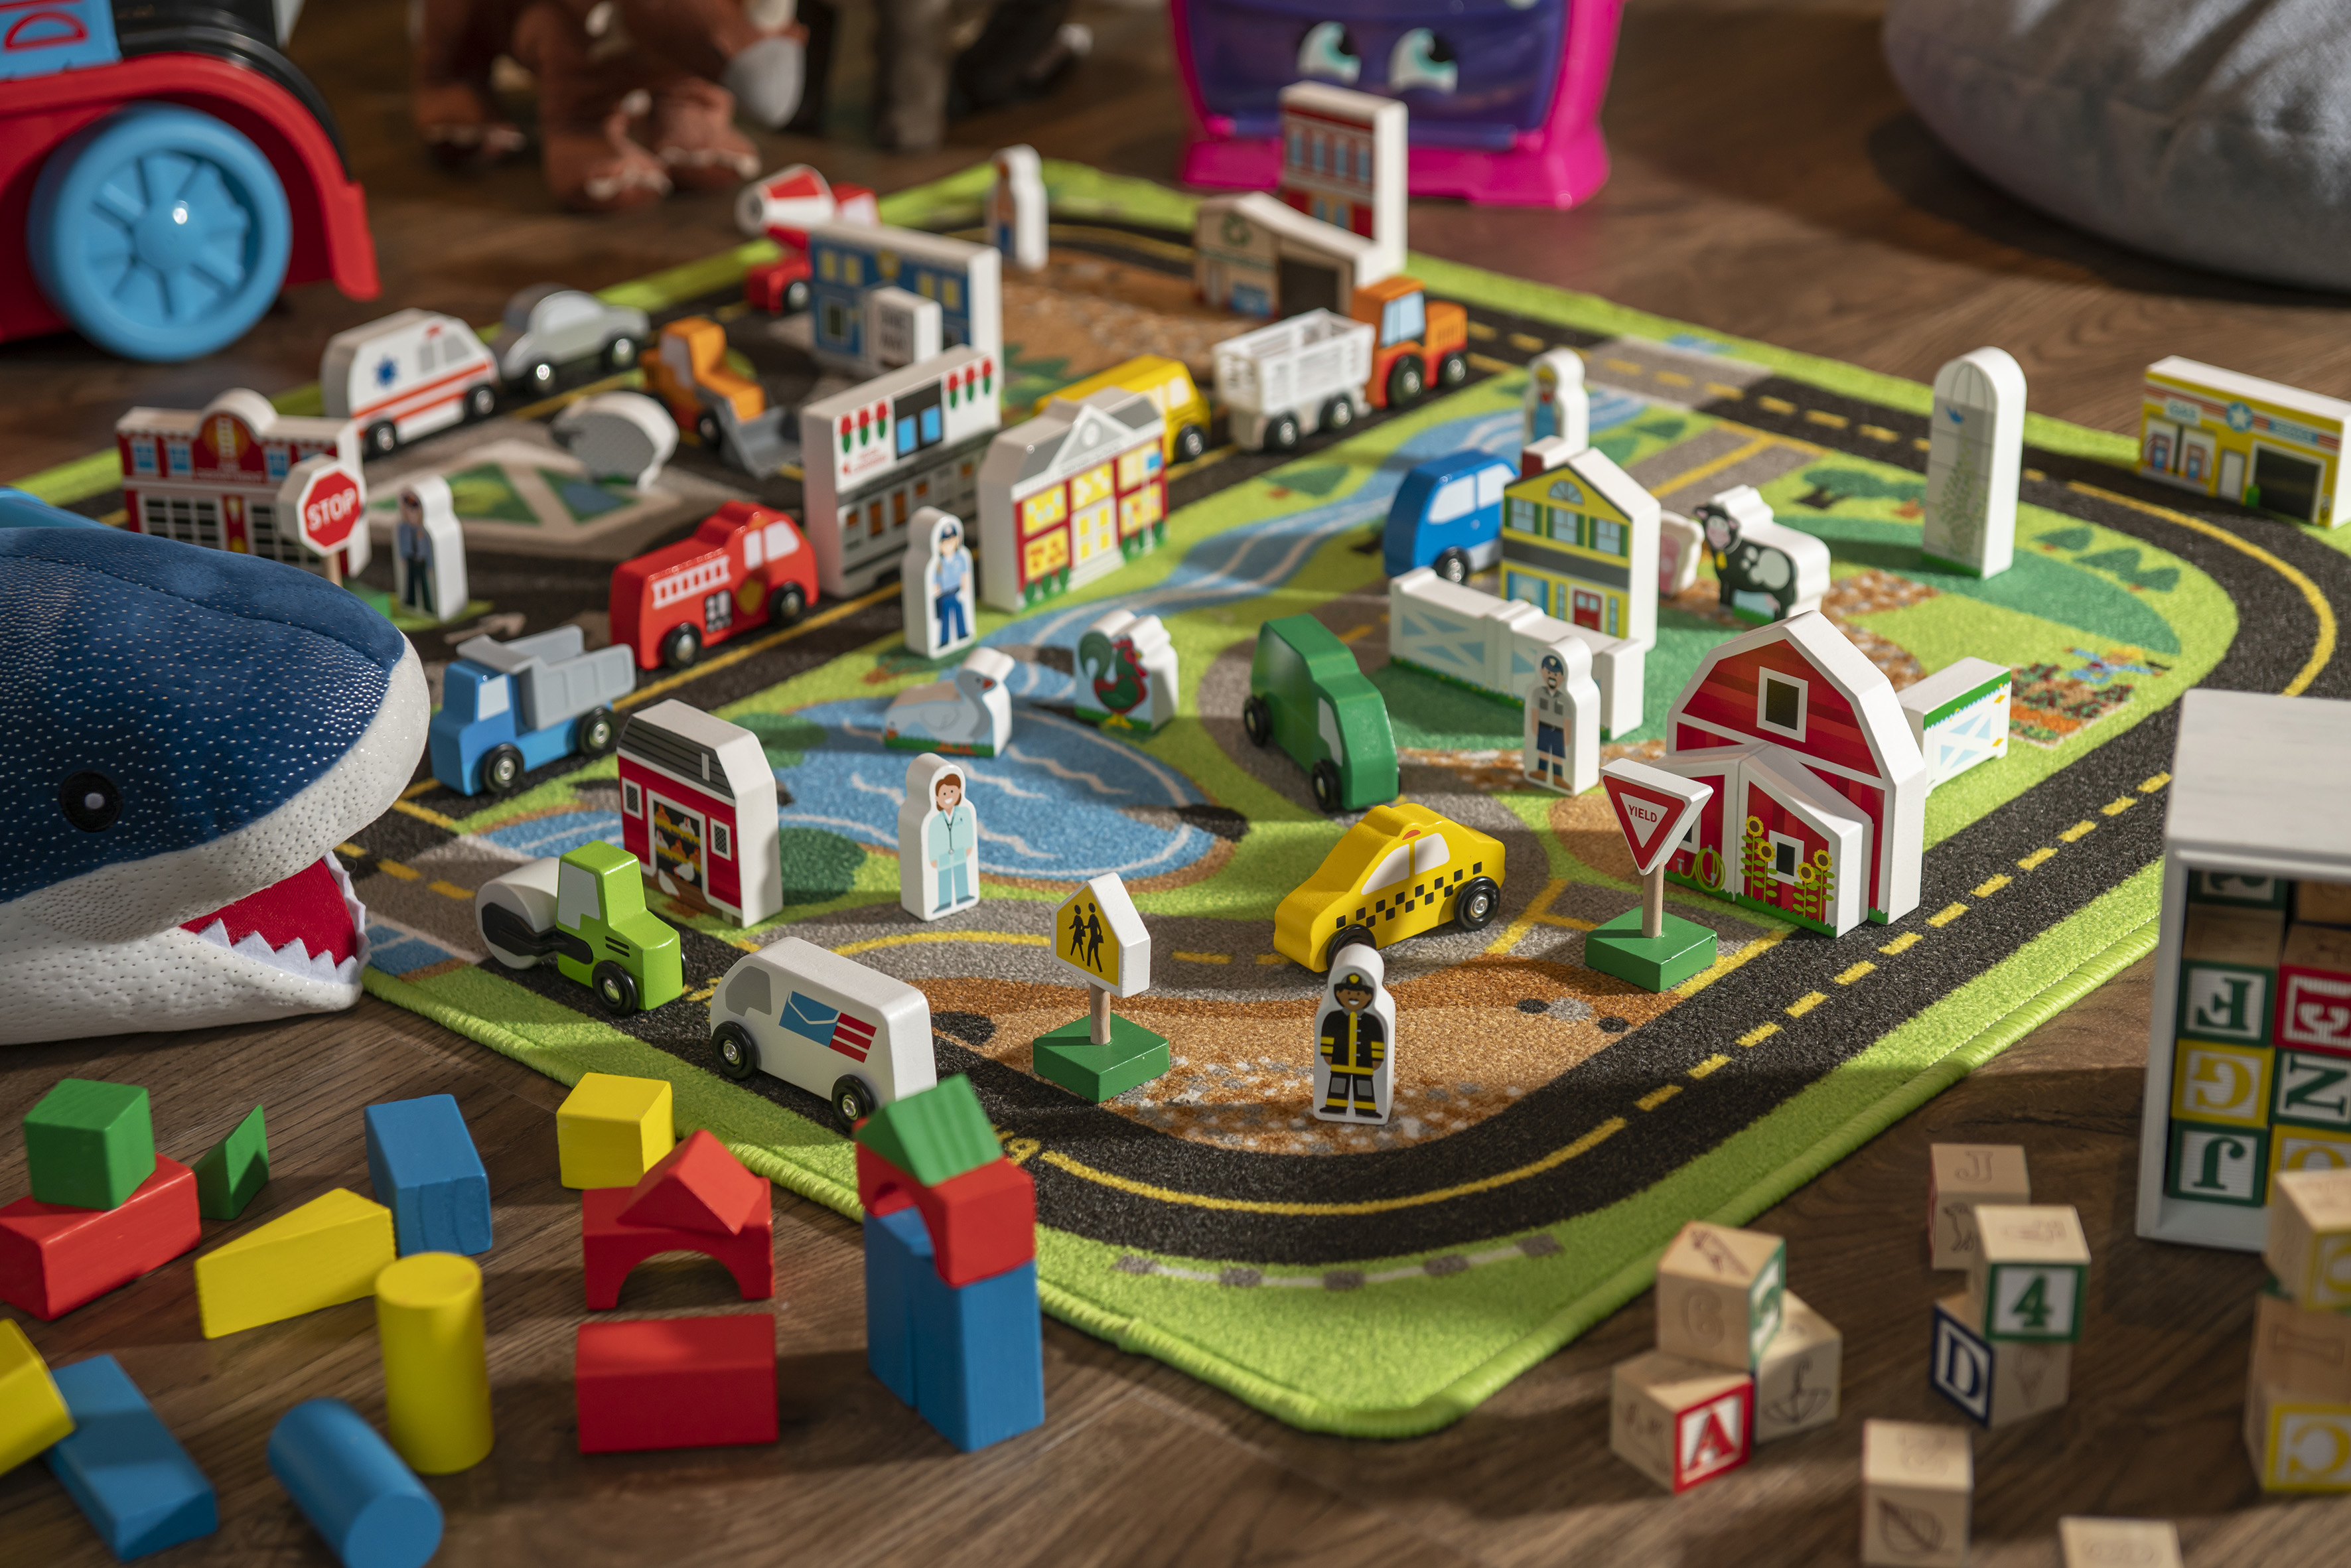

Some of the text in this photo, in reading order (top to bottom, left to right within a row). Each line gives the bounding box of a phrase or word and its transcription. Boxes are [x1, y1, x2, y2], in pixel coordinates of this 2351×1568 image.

[307, 487, 356, 531] STOP
[1628, 804, 1658, 823] YIELD
[2011, 1273, 2054, 1327] 4
[1946, 1330, 1980, 1398] D
[1683, 1407, 1738, 1471] A
